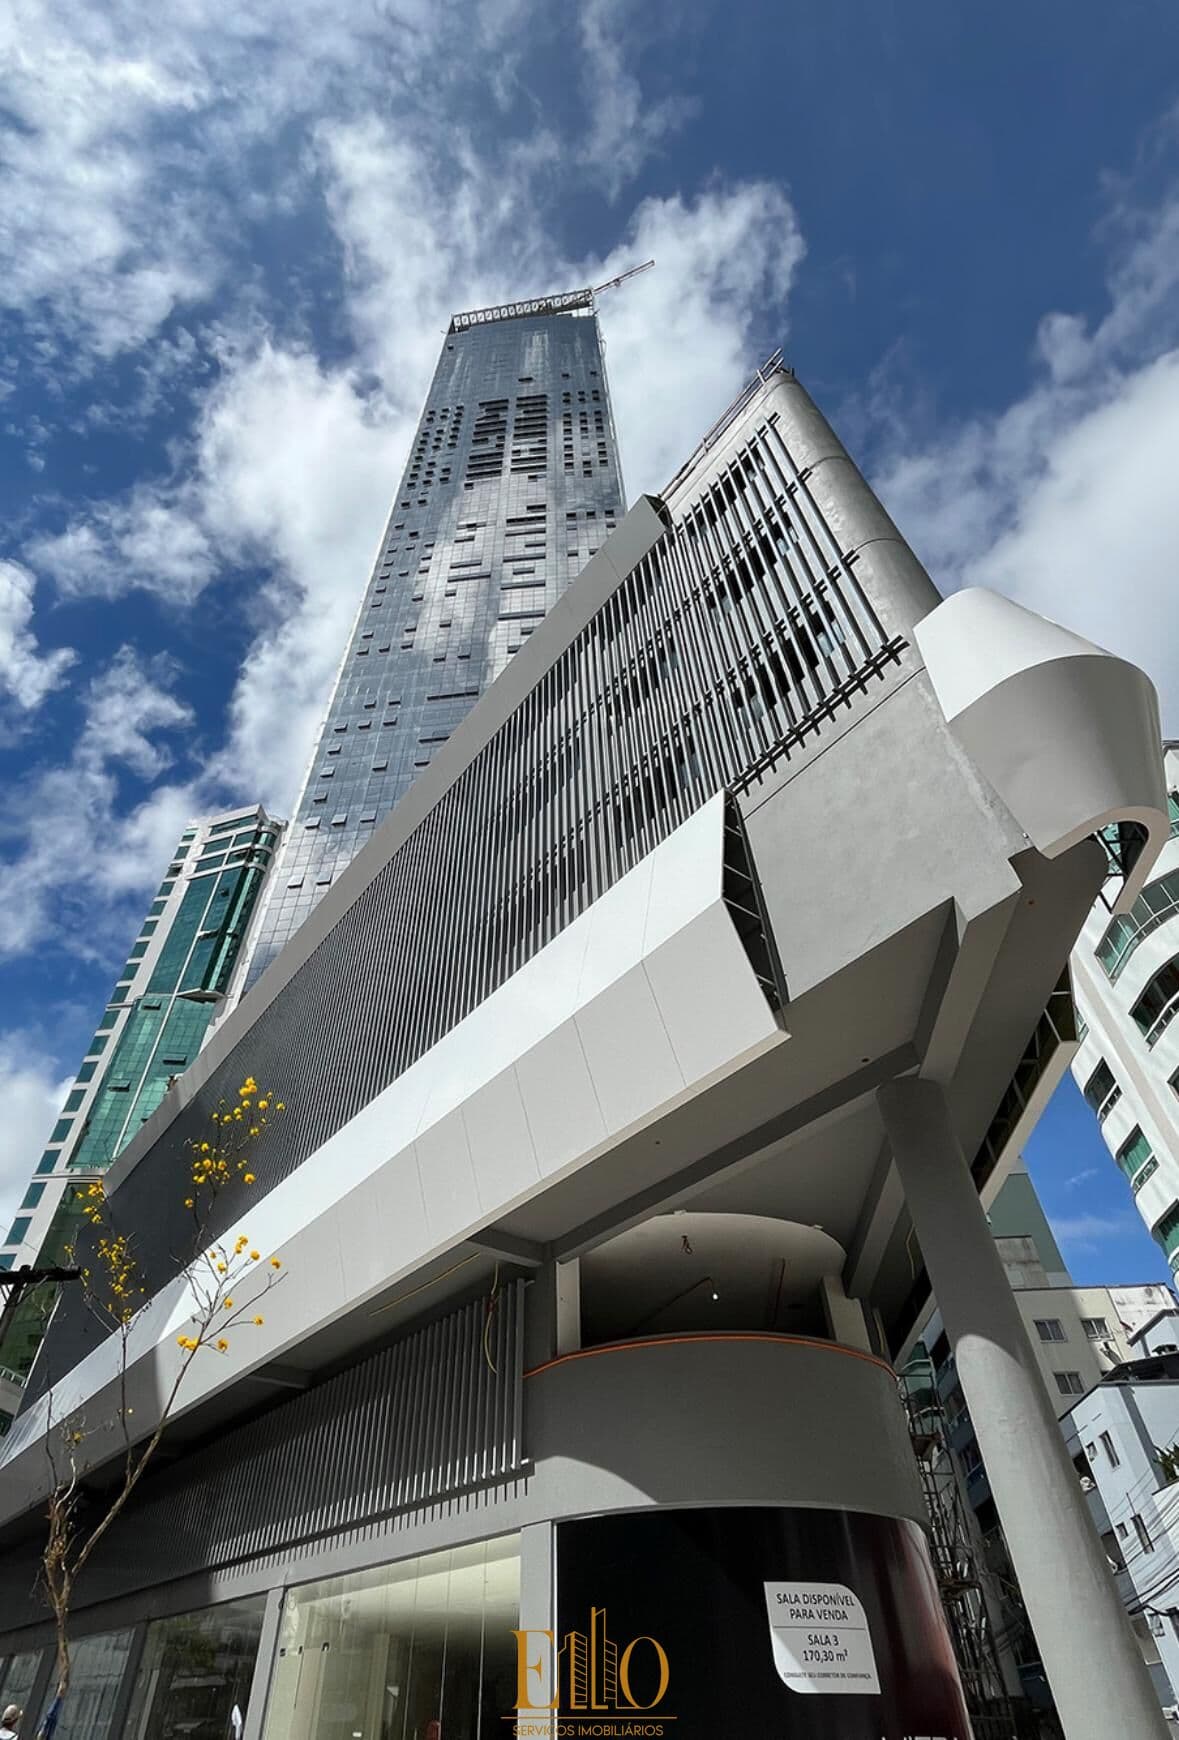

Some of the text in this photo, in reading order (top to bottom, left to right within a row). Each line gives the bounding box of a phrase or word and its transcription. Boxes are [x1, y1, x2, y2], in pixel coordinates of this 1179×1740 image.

[776, 1591, 855, 1607] SALA DISPONÍVEL
[789, 1608, 849, 1621] PARA VENDA
[807, 1634, 840, 1646] SALA 3
[803, 1649, 835, 1663] 170,30
